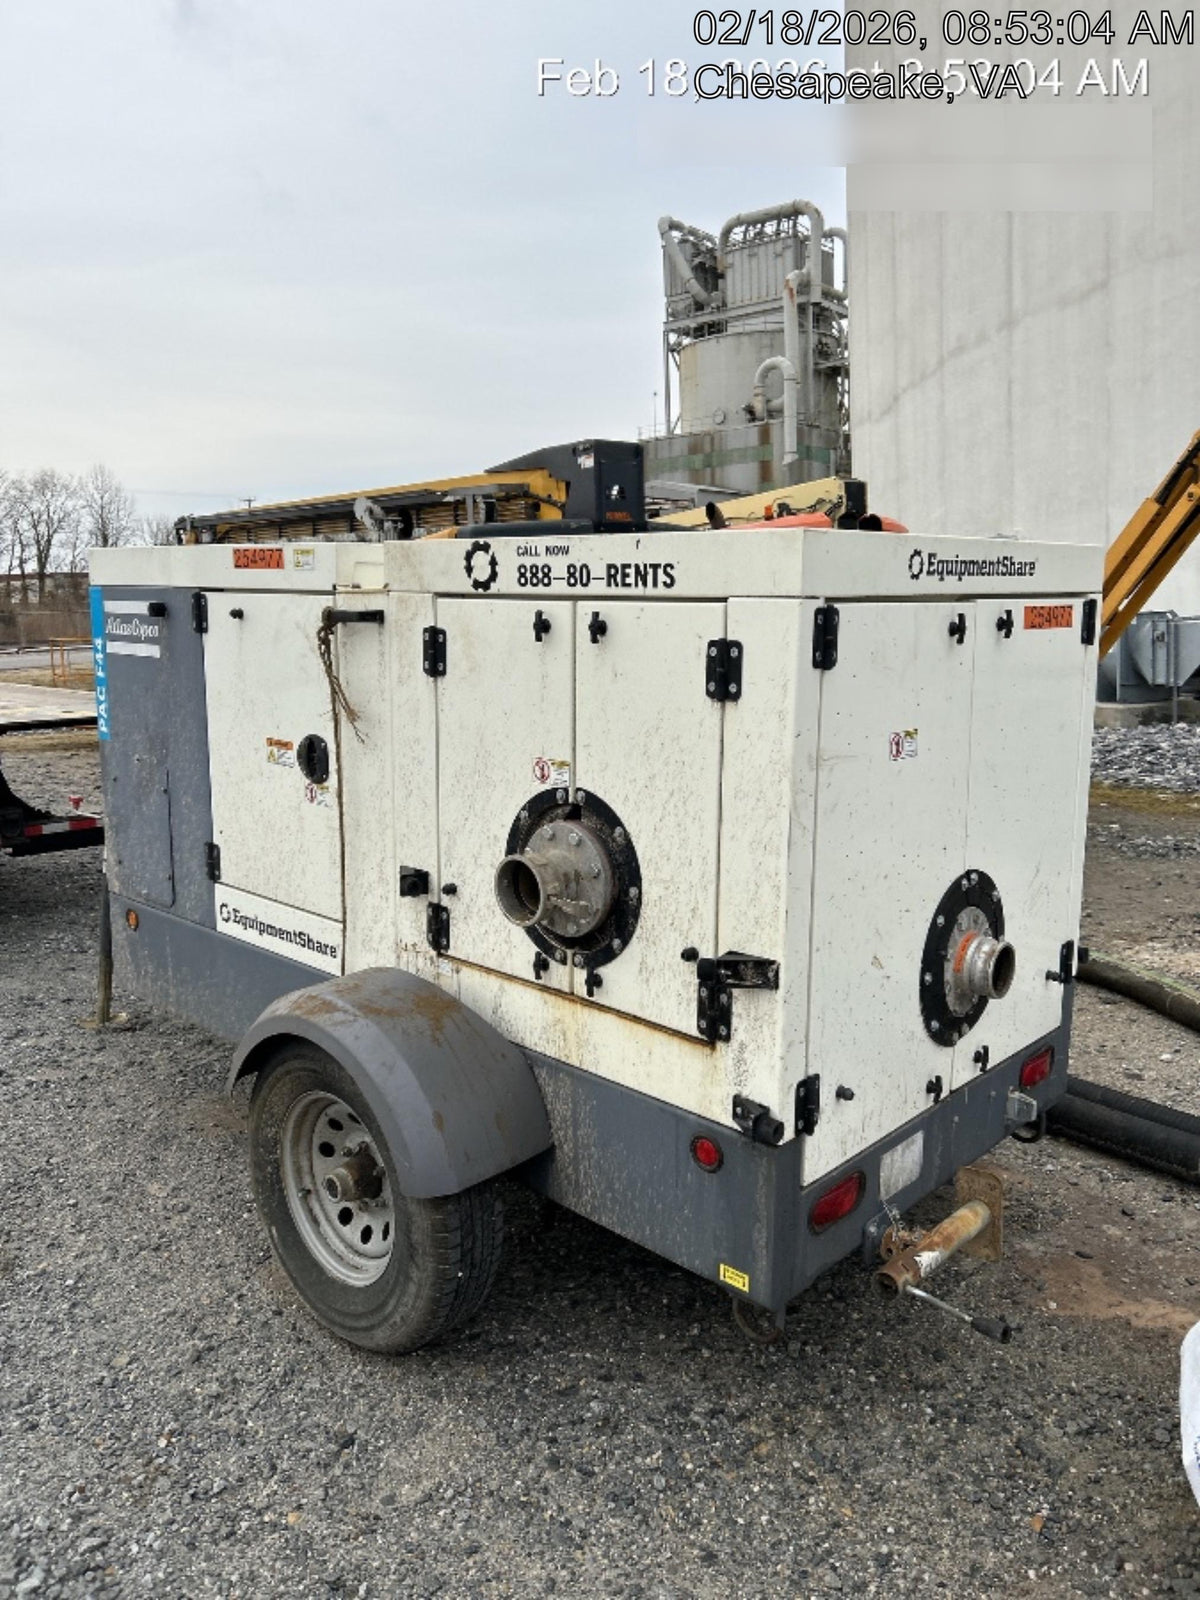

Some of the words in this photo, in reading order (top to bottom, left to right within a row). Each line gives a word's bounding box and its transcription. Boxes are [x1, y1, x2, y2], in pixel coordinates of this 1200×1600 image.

[516, 545, 541, 557] CALL
[545, 545, 570, 557] NOW
[516, 563, 676, 588] 888-80-RENTS
[926, 552, 1036, 582] EquipmentShare
[97, 685, 109, 733] PAC
[232, 908, 337, 959] EquipmentShare
